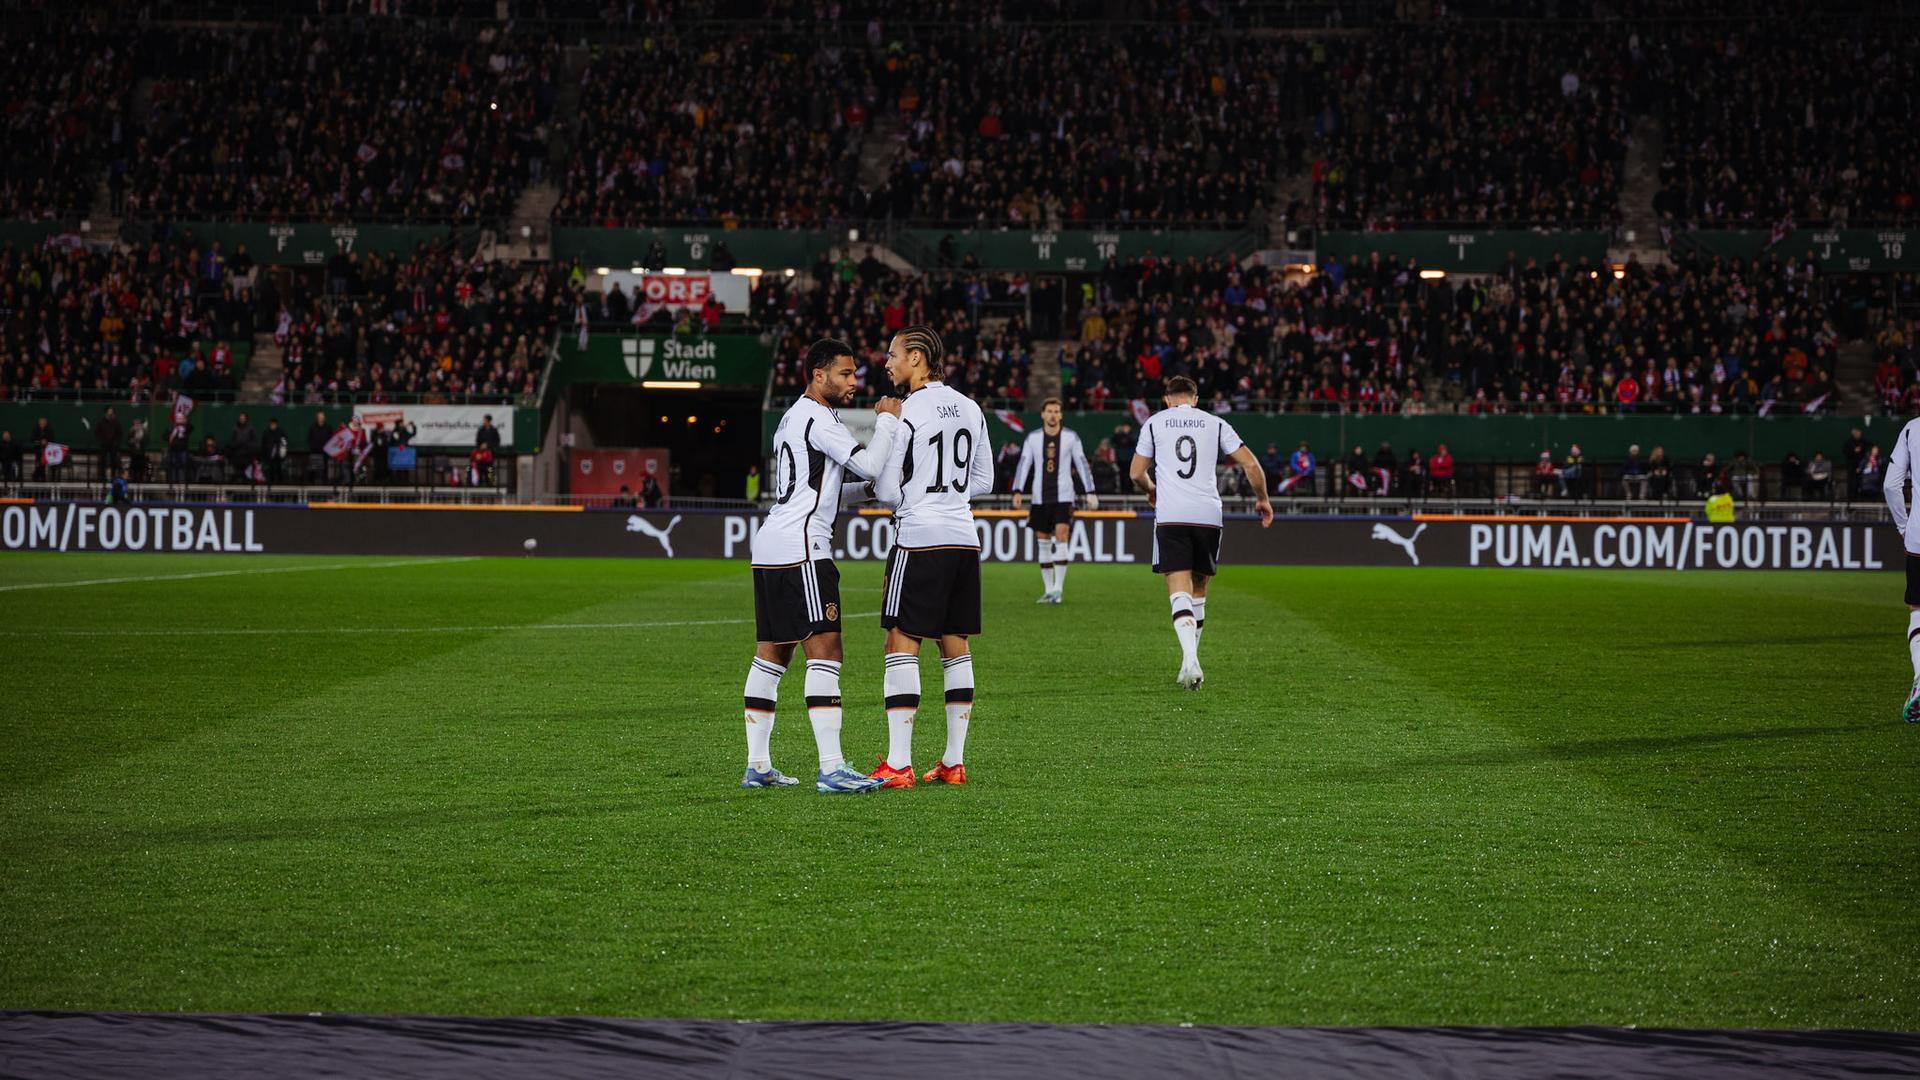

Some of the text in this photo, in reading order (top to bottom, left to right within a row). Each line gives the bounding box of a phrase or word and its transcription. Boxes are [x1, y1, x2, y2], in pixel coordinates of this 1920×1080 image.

[1881, 243, 1903, 260] 19
[646, 280, 706, 300] ORF
[663, 339, 717, 359] Stadt
[662, 360, 717, 379] Wien
[936, 403, 961, 419] SANÉ
[1165, 418, 1206, 428] FÜLLKRUG
[926, 428, 972, 493] 19
[1175, 435, 1197, 479] 9
[775, 441, 796, 504] 0
[1470, 522, 1883, 570] PUMA.COM/FOOTBALL
